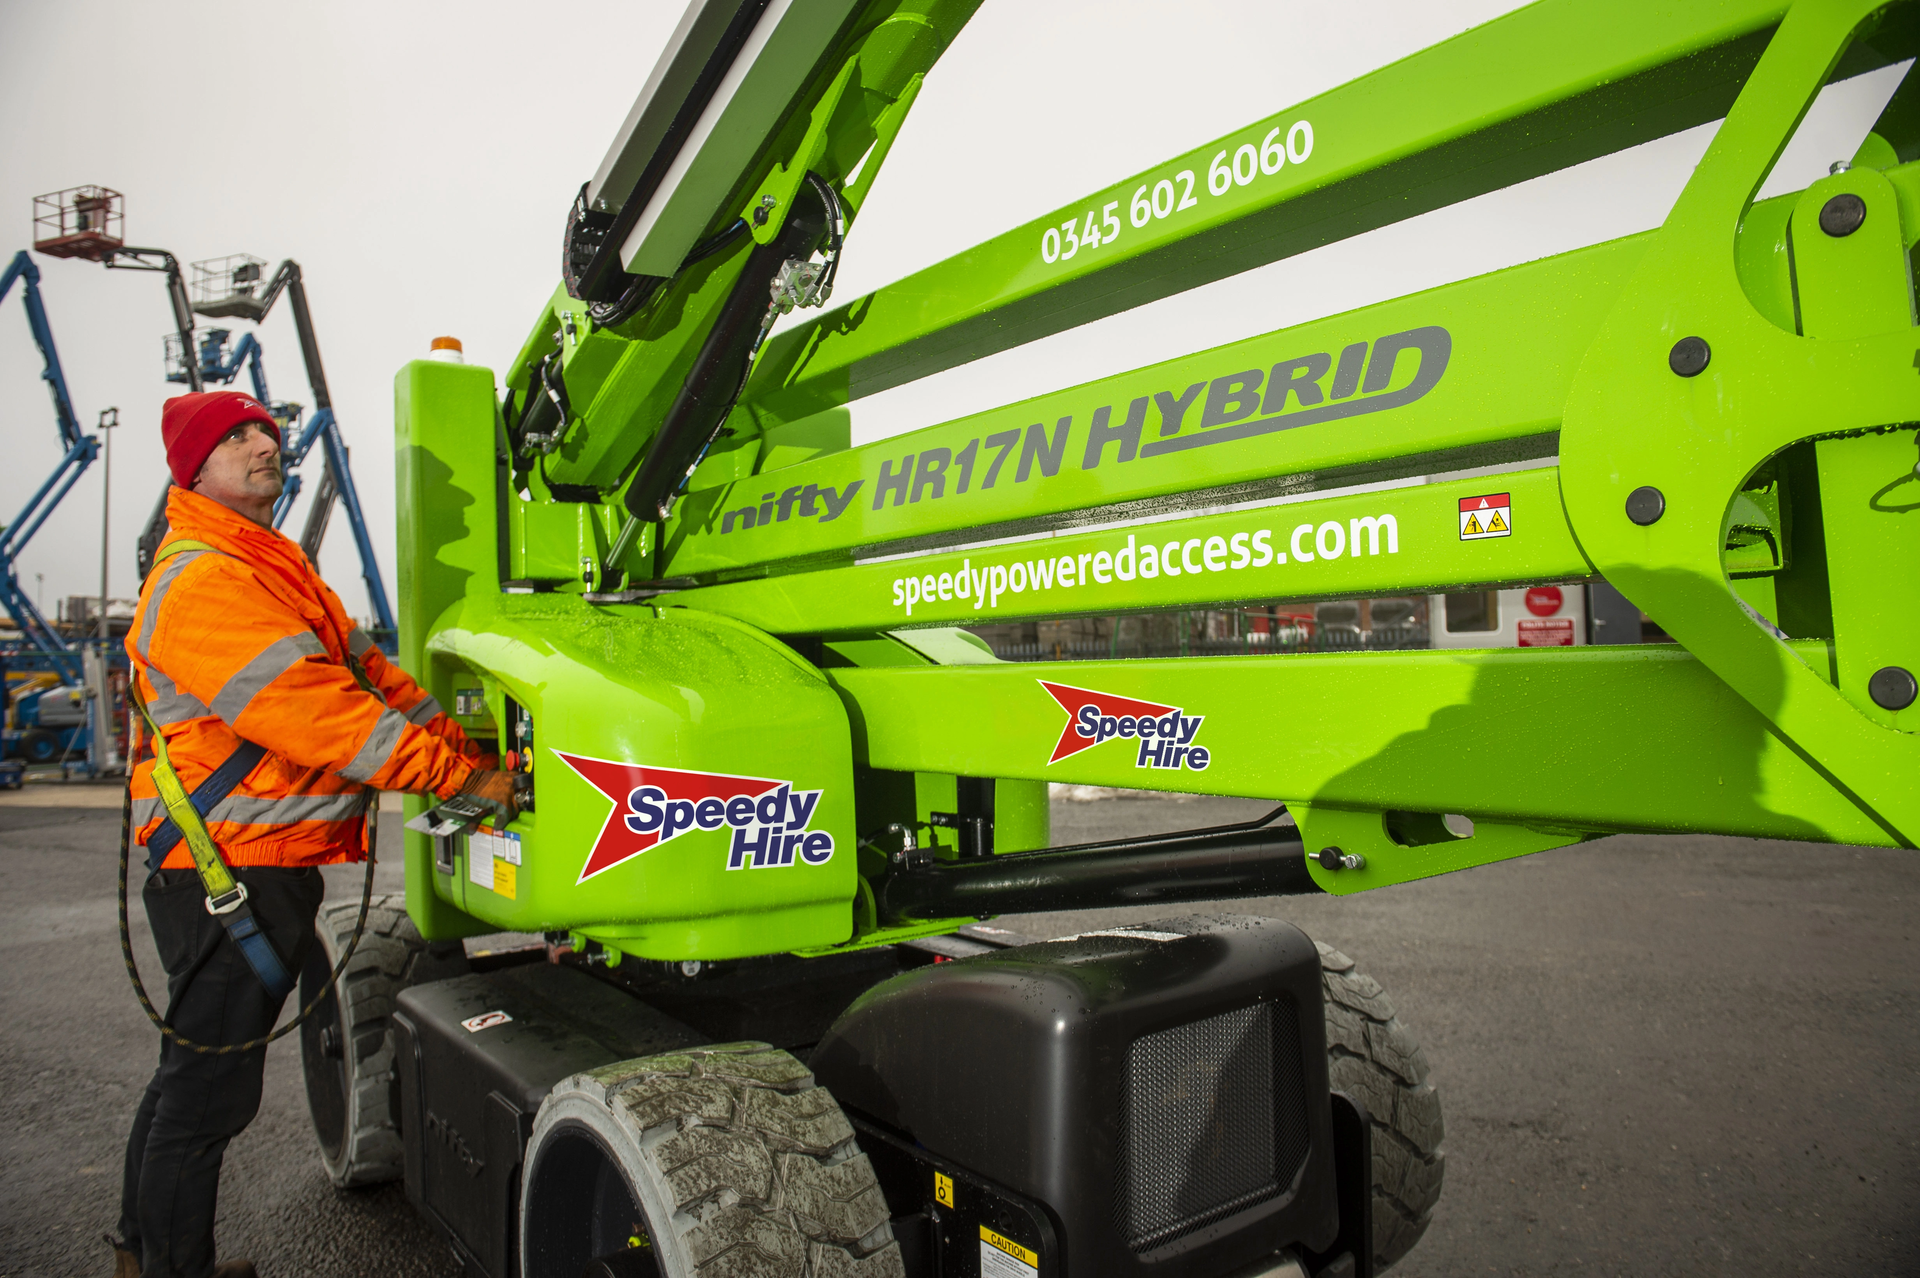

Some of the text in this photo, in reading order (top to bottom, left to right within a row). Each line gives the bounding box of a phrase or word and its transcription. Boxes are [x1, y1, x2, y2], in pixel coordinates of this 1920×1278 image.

[1041, 119, 1314, 264] 0345 602 6060
[720, 325, 1452, 535] nifty HR17N HYBRID
[892, 513, 1399, 615] speedypoweredaccess.com
[1076, 705, 1202, 744] Speedy
[1137, 739, 1209, 770] Hire
[626, 783, 820, 842] Speedy
[729, 826, 832, 868] Hire
[991, 1233, 1026, 1260] CAUTION
